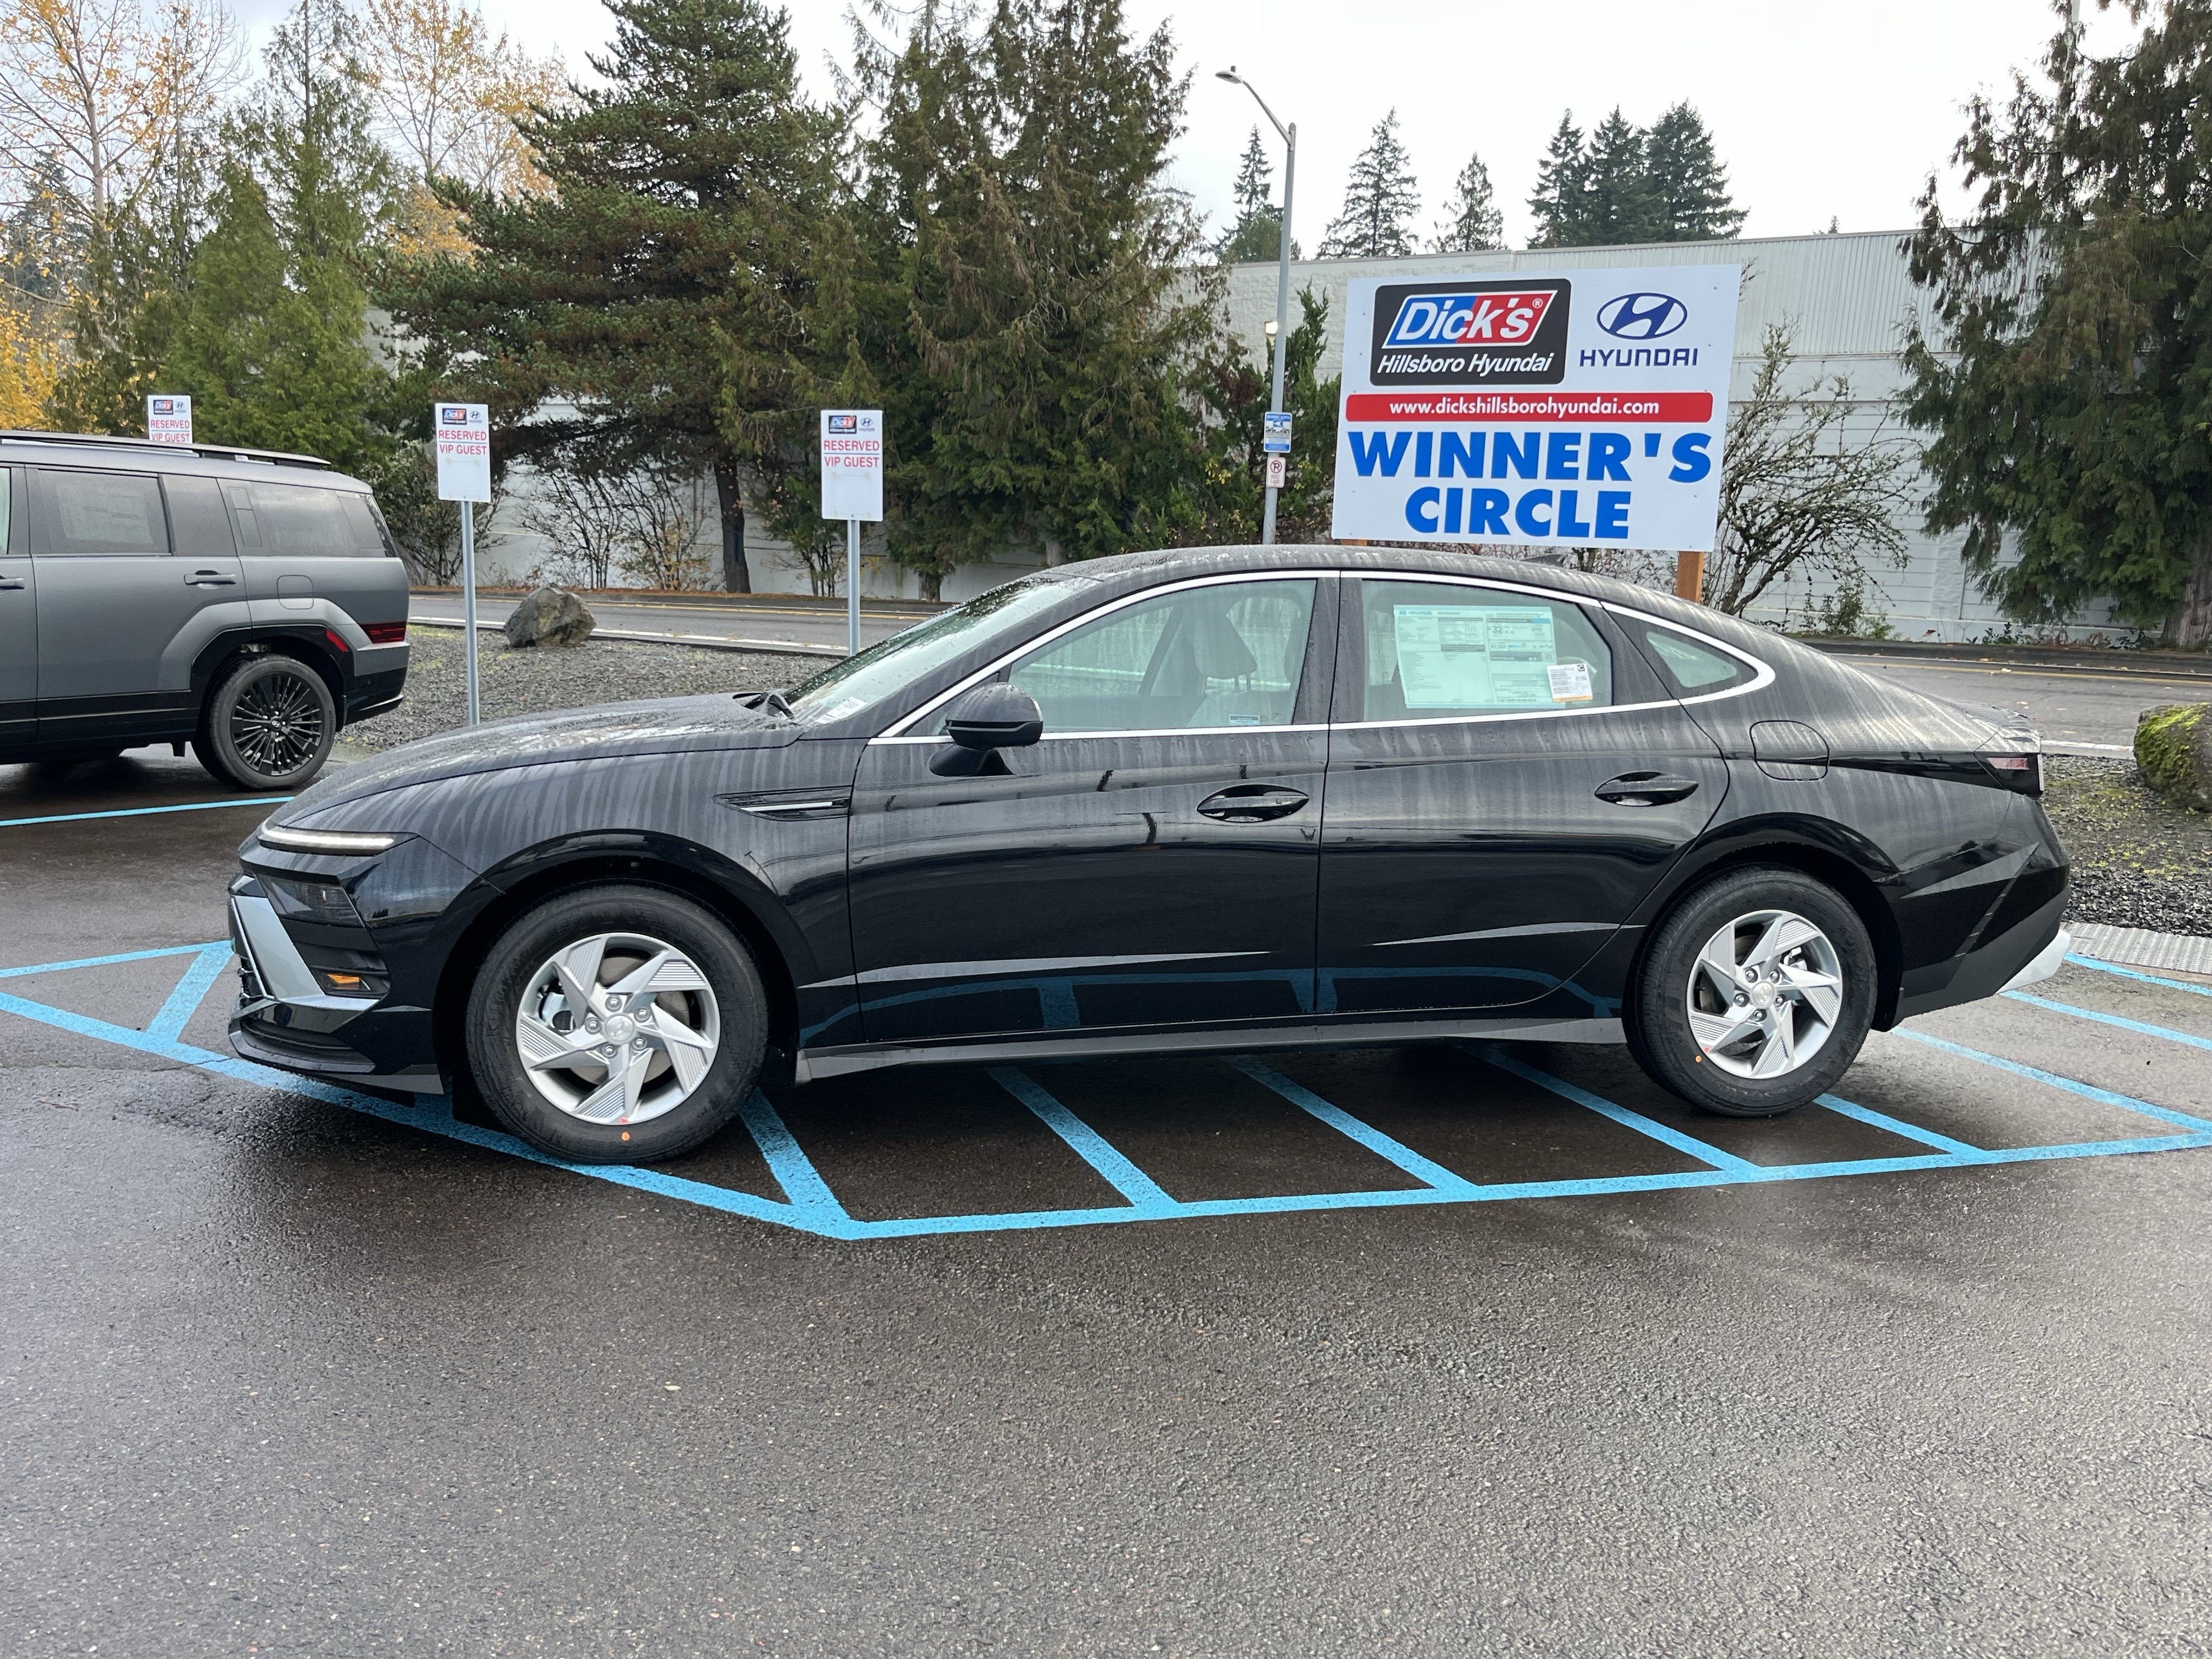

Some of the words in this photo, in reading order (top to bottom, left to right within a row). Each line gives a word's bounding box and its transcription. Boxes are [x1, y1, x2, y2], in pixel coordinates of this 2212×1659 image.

[1395, 298, 1534, 341] Dick's
[1377, 354, 1465, 374] Hillsboro
[1467, 353, 1555, 377] Hyundai
[1579, 348, 1698, 367] HYUNDAI
[1389, 397, 1660, 418] www.dickshillsborohyundai.com
[150, 420, 190, 429] RESERVED
[151, 432, 163, 442] VIP
[165, 433, 190, 443] GUEST
[438, 430, 487, 441] RESERVED
[439, 444, 454, 454] VIP
[456, 444, 487, 455] GUEST
[823, 440, 880, 452] RESERVED
[824, 456, 840, 467] VIP
[844, 456, 879, 467] GUEST
[1347, 431, 1712, 483] WINNER'S
[1405, 487, 1632, 539] CIRCLE
